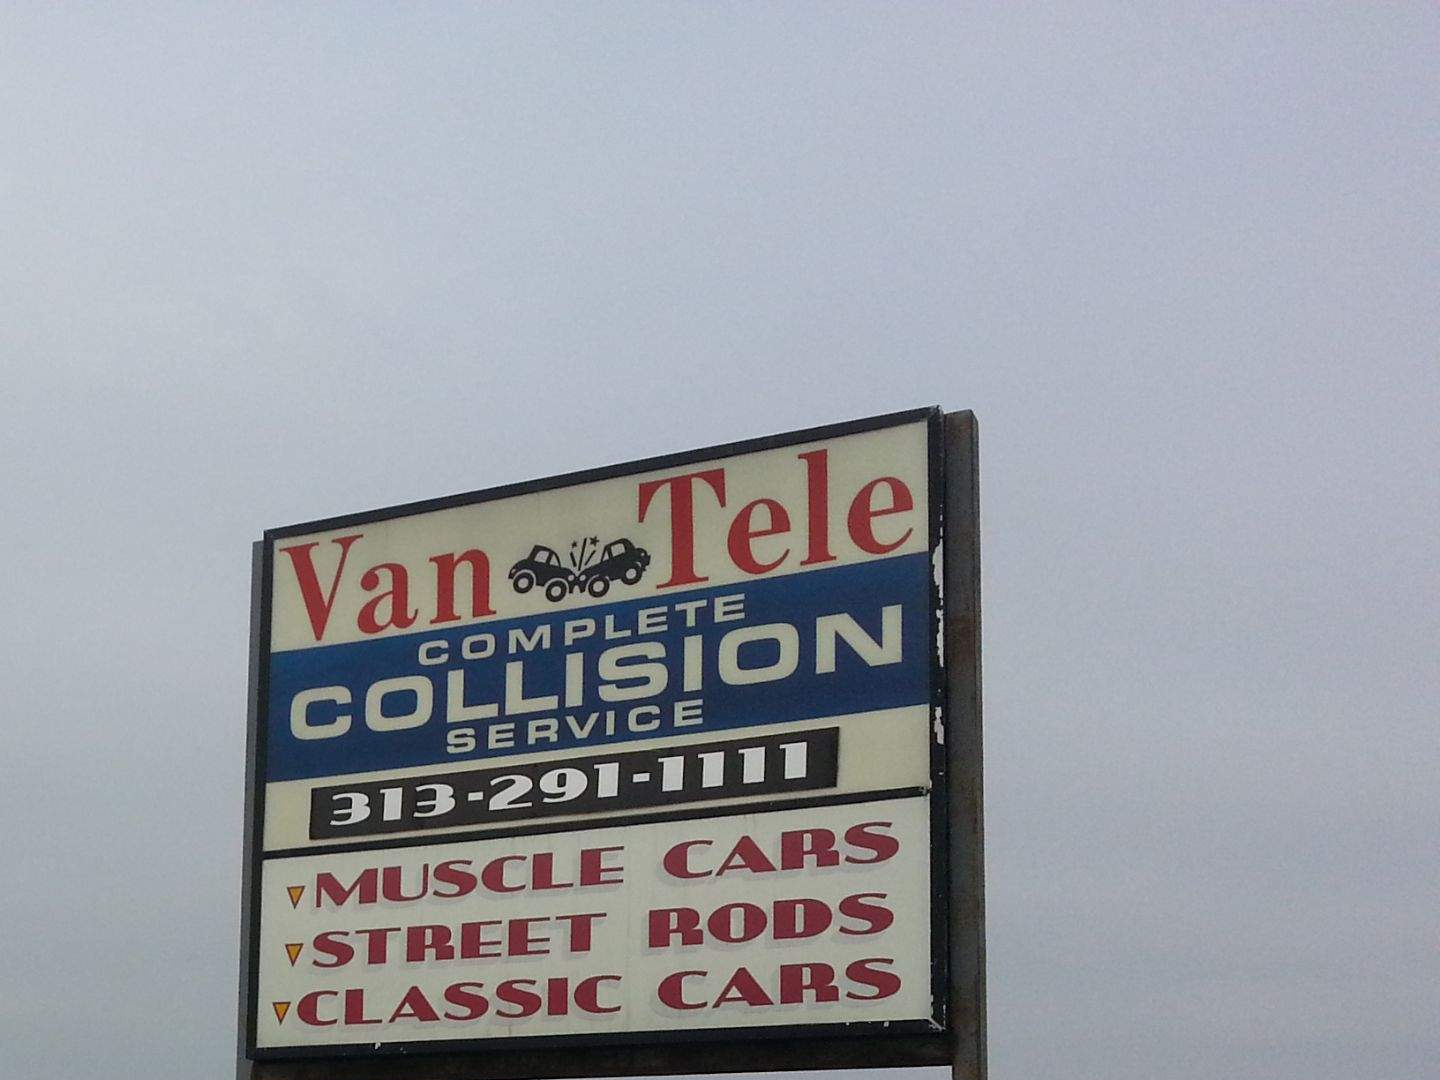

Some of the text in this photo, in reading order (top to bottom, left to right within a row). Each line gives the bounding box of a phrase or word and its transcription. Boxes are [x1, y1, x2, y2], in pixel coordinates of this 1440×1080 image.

[279, 449, 915, 642] Van Tele
[418, 593, 747, 666] COMPLETE
[289, 604, 904, 741] COLLISION
[446, 700, 705, 755] SERVICE
[330, 741, 810, 826] 313-291-1111
[315, 822, 900, 908] MUSCLE CARS
[312, 892, 895, 968] STREET RODS
[296, 958, 902, 1027] CLASSIC CARS
